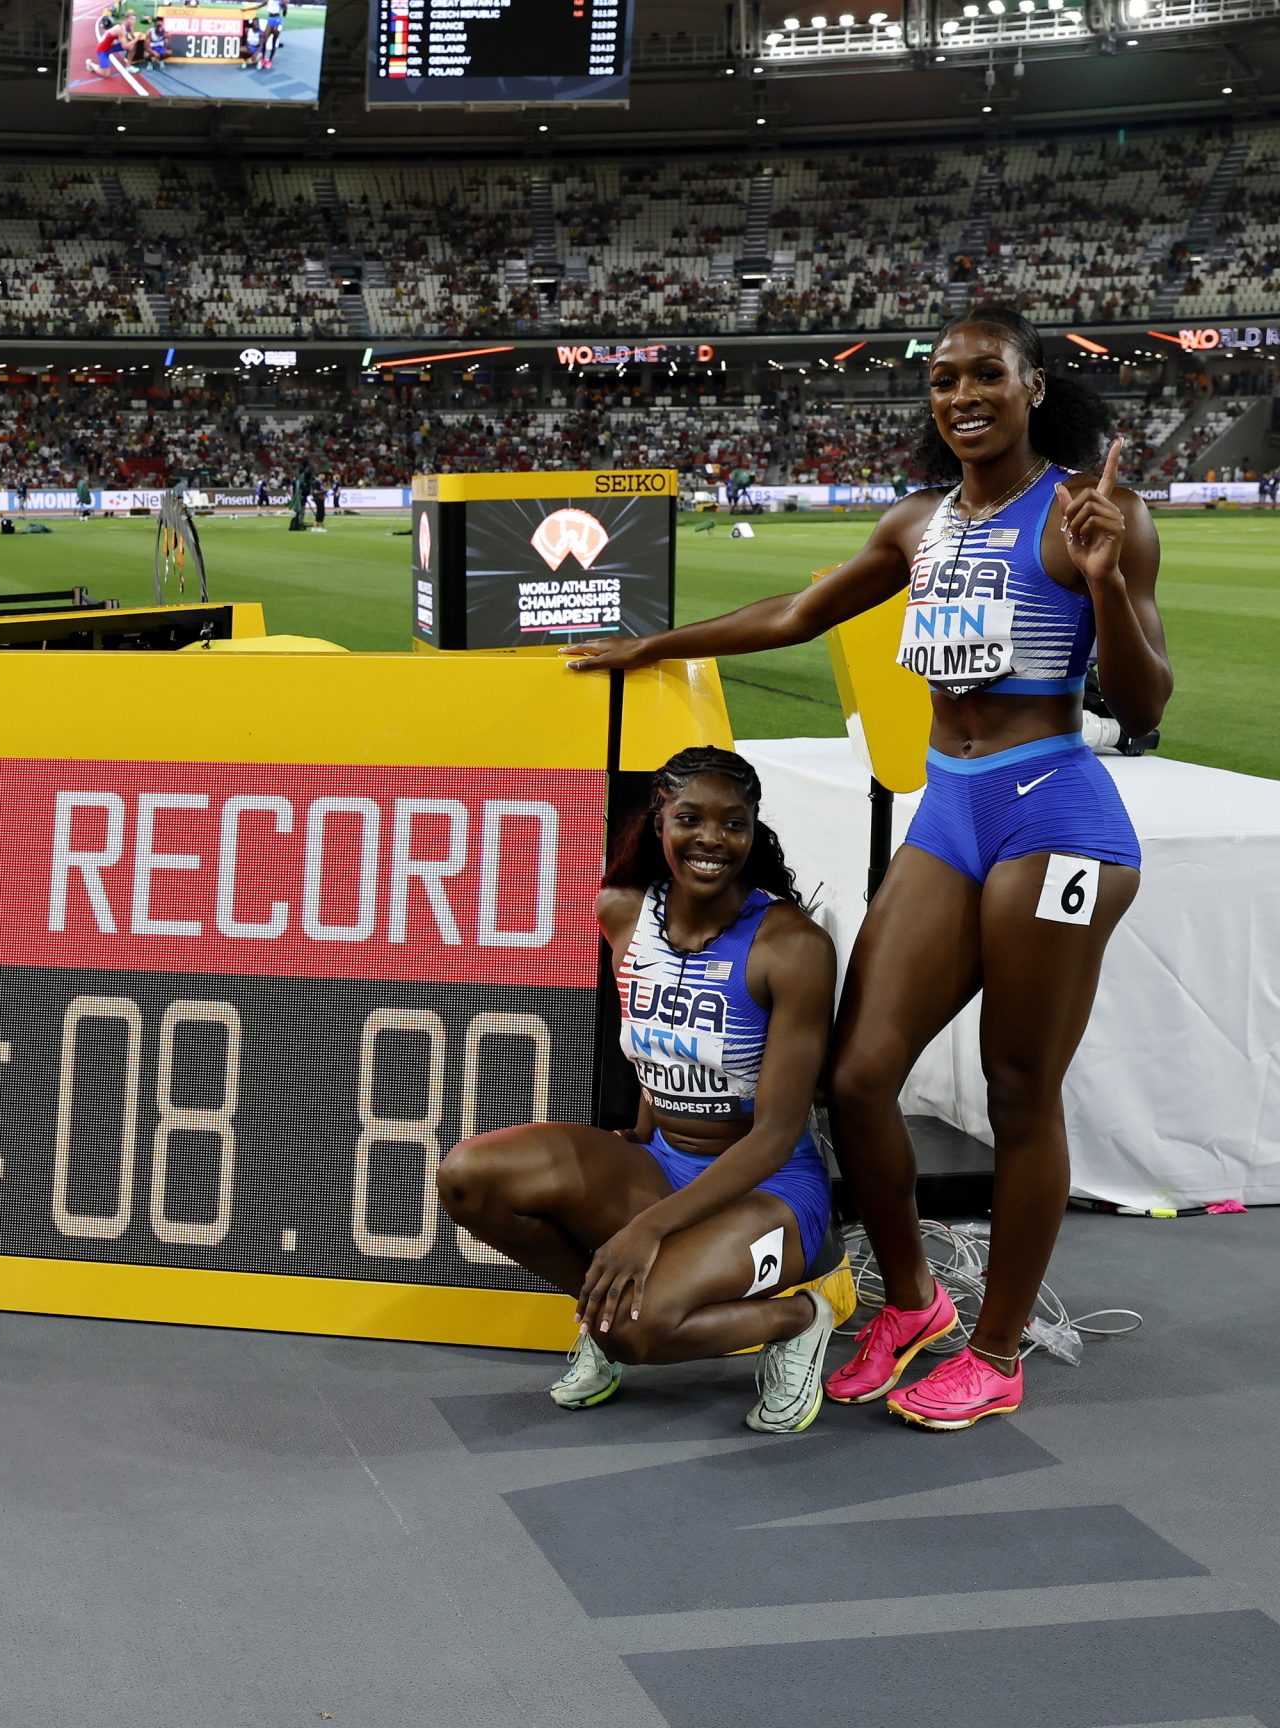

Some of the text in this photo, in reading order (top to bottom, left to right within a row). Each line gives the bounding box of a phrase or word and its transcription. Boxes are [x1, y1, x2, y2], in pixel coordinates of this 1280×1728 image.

[430, 10, 460, 19] CZECH
[460, 10, 500, 19] REPUBLIC
[430, 22, 464, 30] FRANCE
[186, 35, 240, 58] 3:08.80
[429, 33, 467, 42] BELGIUM
[429, 45, 465, 53] IRELAND
[428, 56, 471, 65] GERMANY
[428, 68, 464, 76] POLAND
[595, 473, 666, 493] SEIKO
[215, 493, 253, 506] Pinsent
[519, 579, 620, 595] WORLD ATHLETICS
[910, 559, 1009, 600] USA
[519, 592, 620, 609] CHAMPIONSHIPS
[520, 607, 620, 627] BUDAPEST 23
[915, 604, 985, 640] NTN
[902, 643, 1004, 677] HOLMES
[47, 790, 559, 948] RECORD
[1060, 869, 1087, 915] 6
[628, 980, 726, 1033] USA
[630, 1024, 699, 1062] NTN
[654, 1096, 731, 1113] BUDAPEST 23
